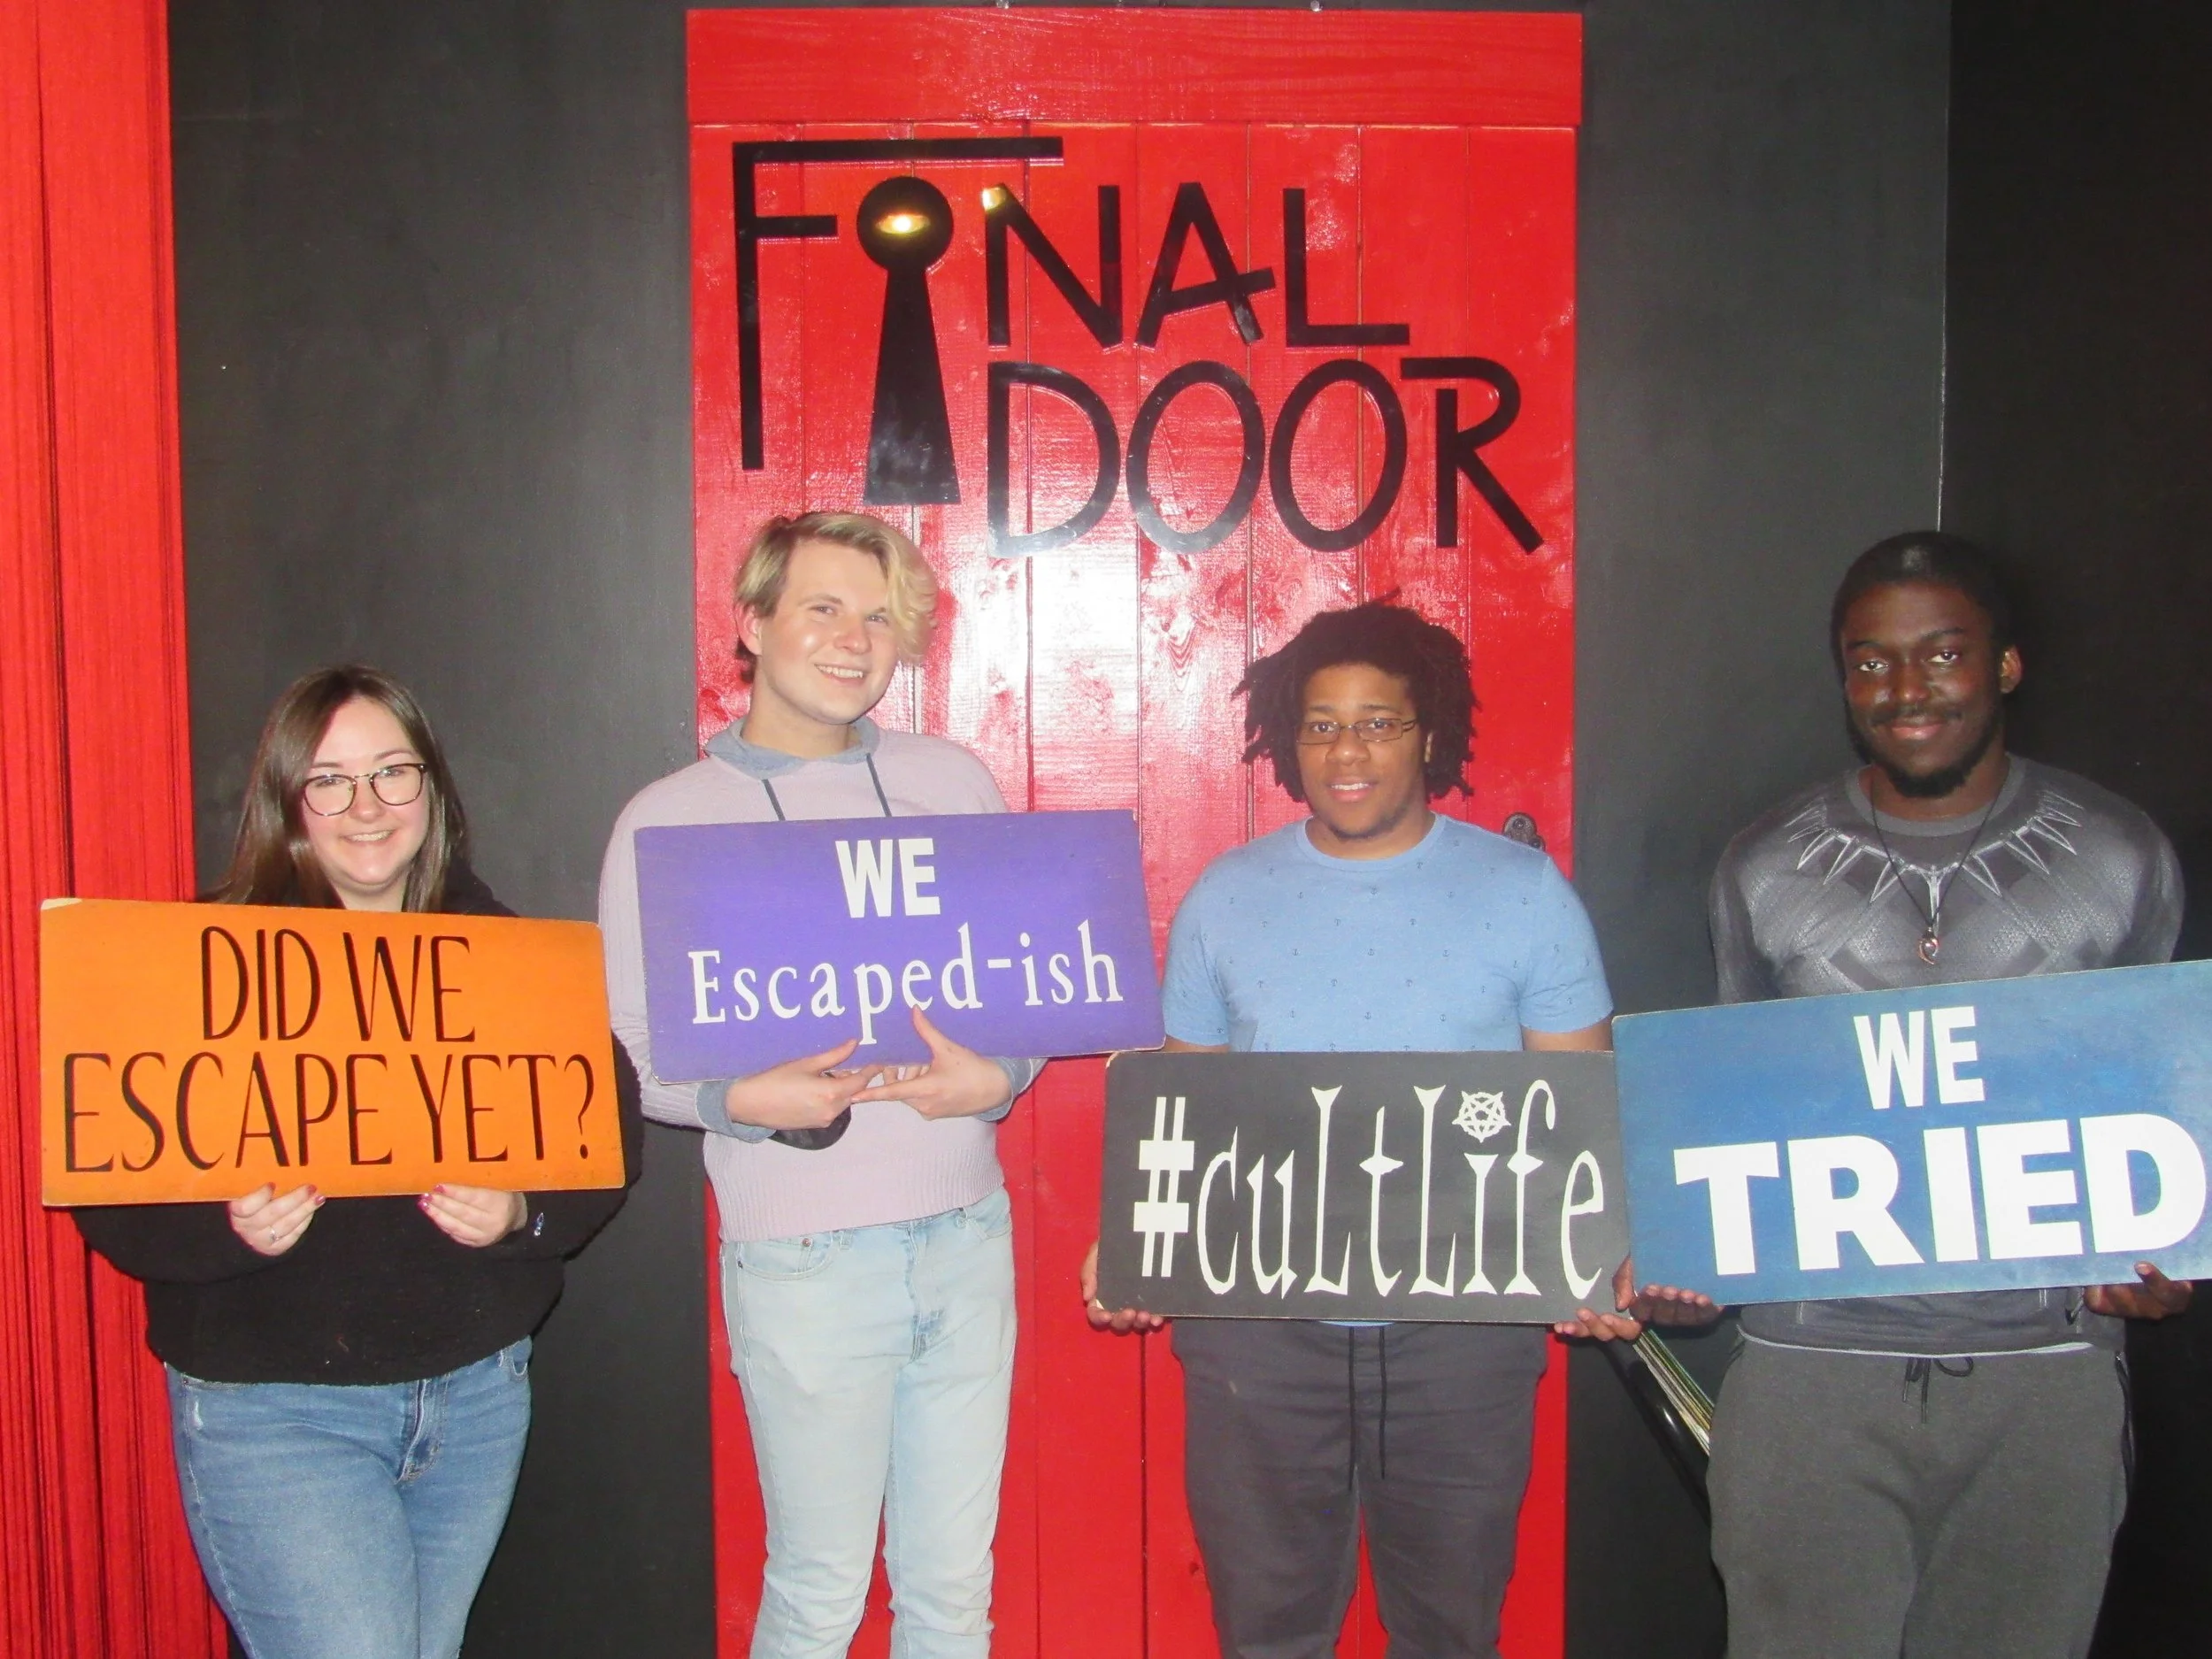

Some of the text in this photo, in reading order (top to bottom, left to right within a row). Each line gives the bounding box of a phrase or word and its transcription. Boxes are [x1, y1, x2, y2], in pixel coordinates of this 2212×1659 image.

[733, 137, 1410, 505] FINAL
[987, 357, 1544, 558] DOOR
[835, 838, 941, 918] WE
[200, 926, 475, 1042] DID WE
[687, 918, 1124, 1046] Escaped-ish
[63, 1051, 595, 1173] ESCAPE YET?
[1853, 1006, 1985, 1110] WE
[1673, 1113, 2207, 1276] TRIED
